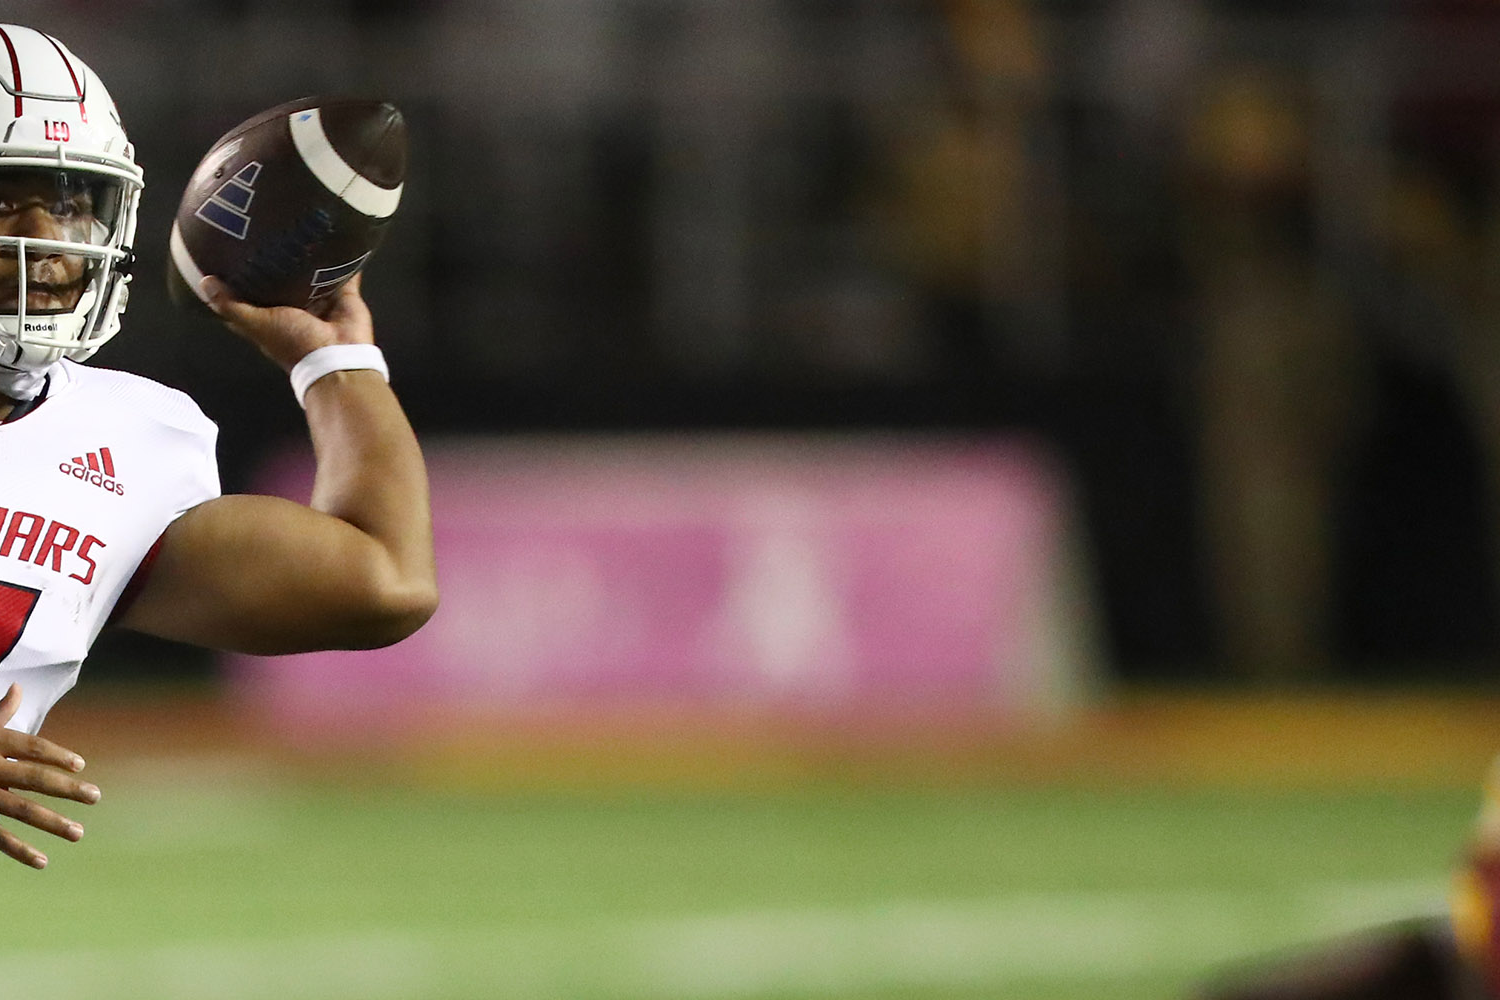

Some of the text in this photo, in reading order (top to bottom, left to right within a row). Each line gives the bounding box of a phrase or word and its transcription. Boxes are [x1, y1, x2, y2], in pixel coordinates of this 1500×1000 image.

[44, 120, 70, 142] LEO
[24, 323, 58, 332] Riddell
[59, 463, 125, 496] adidas
